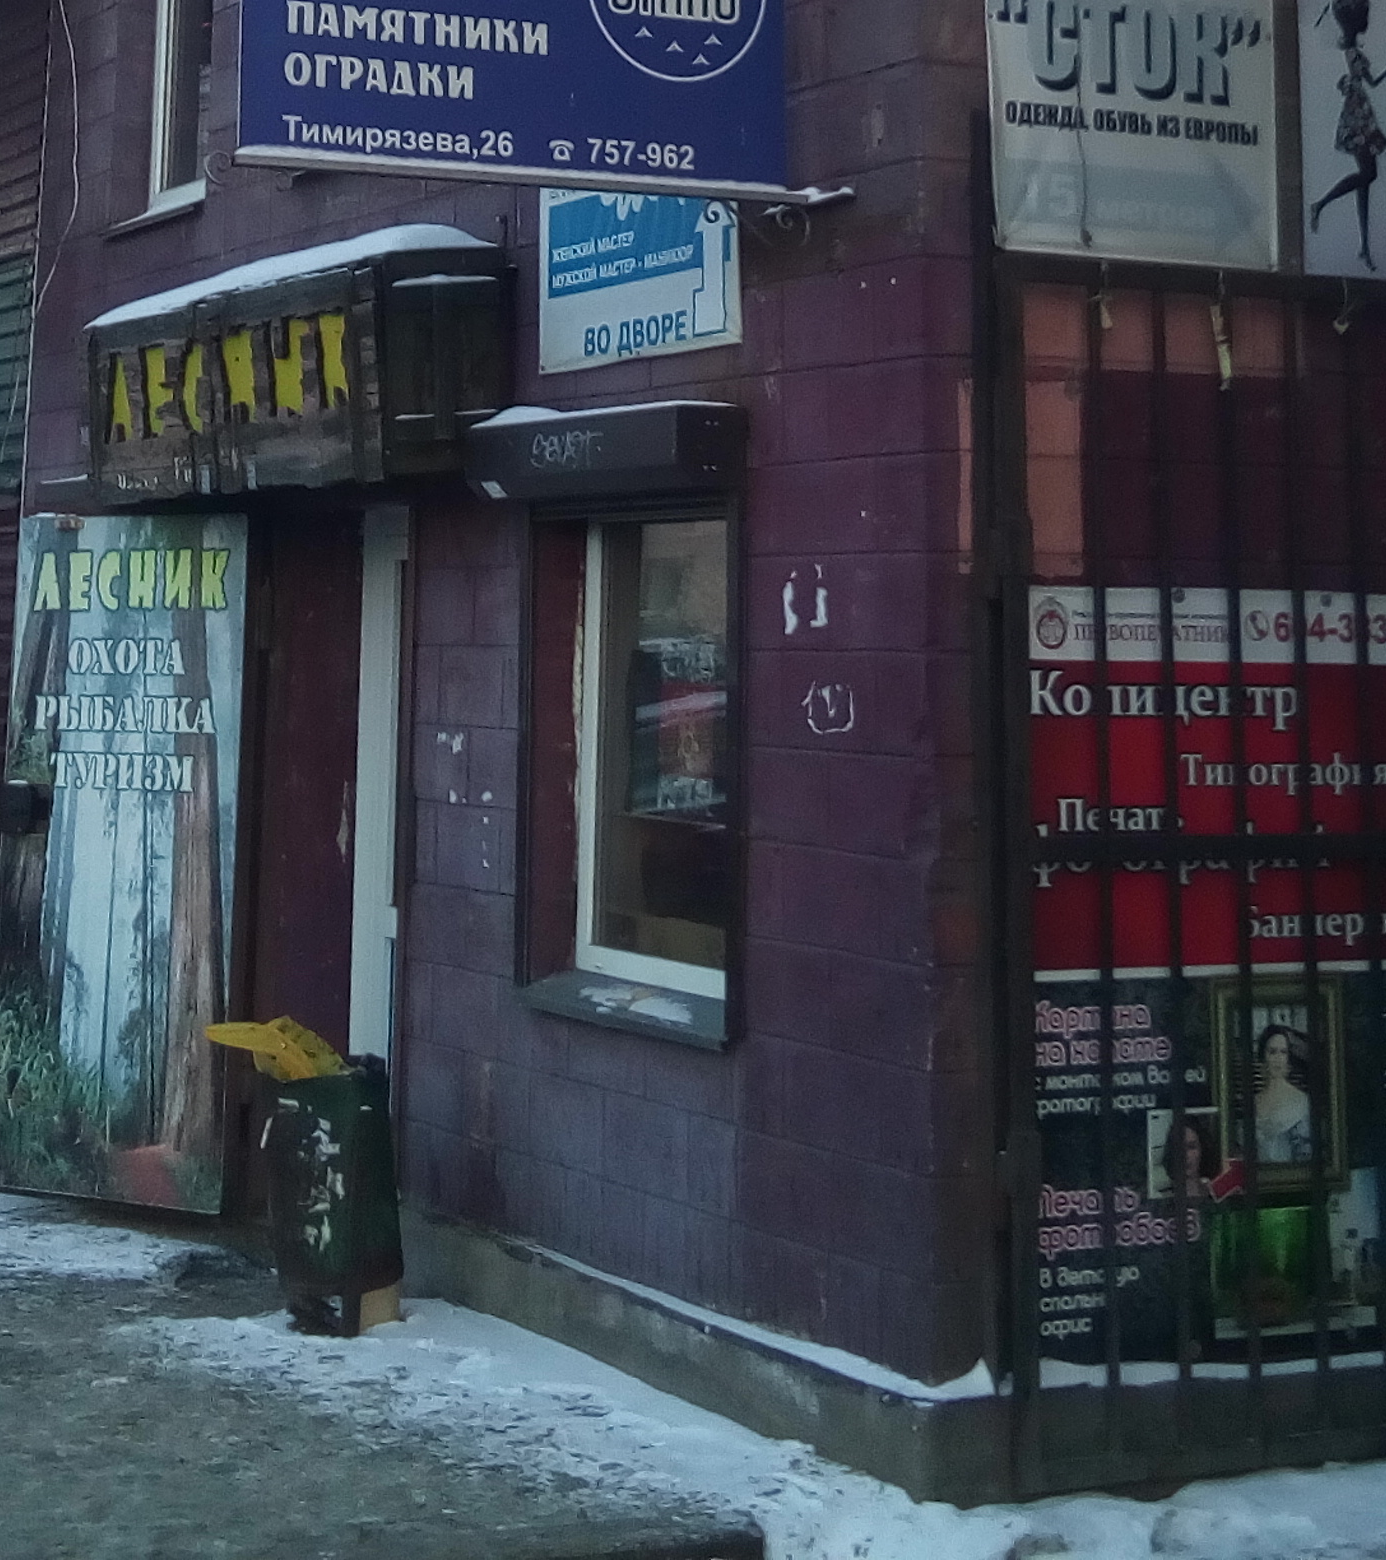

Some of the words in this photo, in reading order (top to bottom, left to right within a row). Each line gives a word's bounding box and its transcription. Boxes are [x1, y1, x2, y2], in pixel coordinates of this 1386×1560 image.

[285, 0, 549, 56] ПАМЯТНИКИ
[284, 52, 476, 101] ОГРАДКИ
[282, 114, 514, 160] Тимирязева,26
[587, 136, 696, 171] 757-962
[1093, 108, 1153, 138] ОБУВЬ
[1156, 114, 1182, 140] ИЗ
[1184, 116, 1259, 147] ЕВРОПЫ
[597, 231, 635, 255] МАСТЕР
[599, 257, 637, 278] МАСТЕР
[584, 324, 611, 357] ВО
[616, 309, 688, 358] ДВОРЕ
[33, 548, 231, 612] ЛЕСНИК
[67, 638, 186, 675] ОХОТА
[34, 694, 216, 734] РЫБАЛКА
[49, 752, 195, 793] ТУРИЗМ
[1057, 797, 1184, 833] Печат
[1039, 1295, 1106, 1313] спальн
